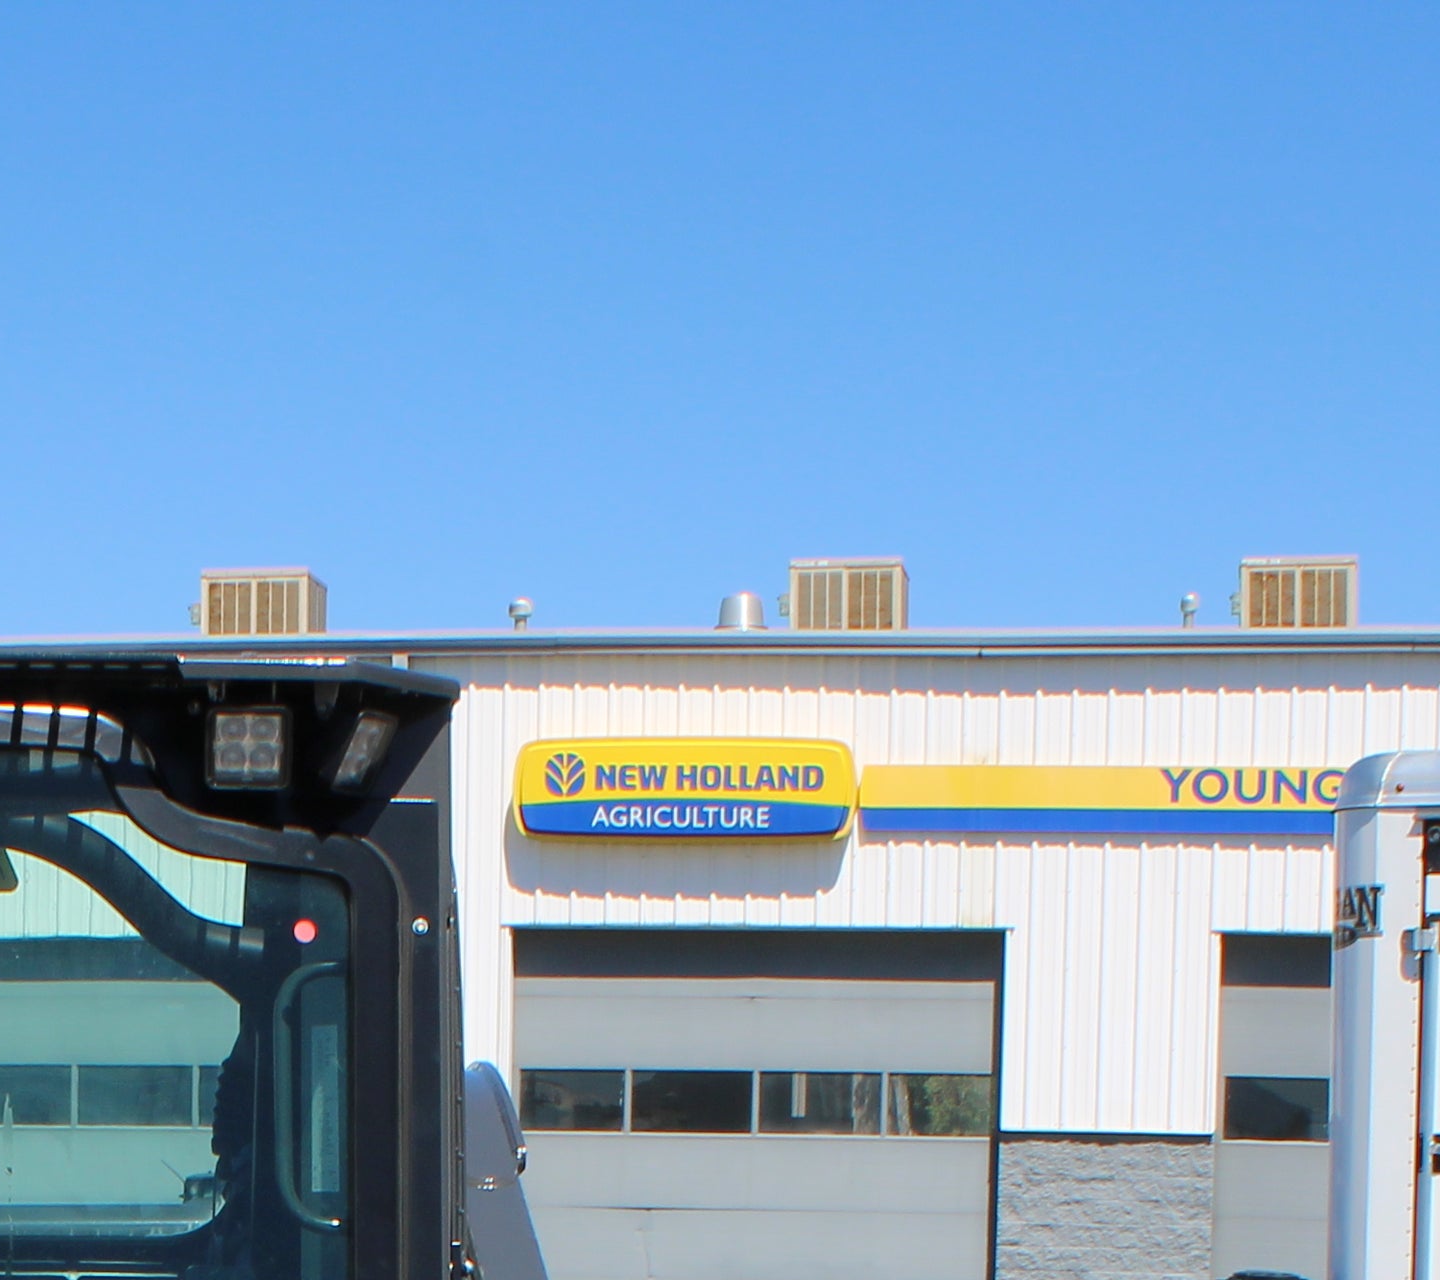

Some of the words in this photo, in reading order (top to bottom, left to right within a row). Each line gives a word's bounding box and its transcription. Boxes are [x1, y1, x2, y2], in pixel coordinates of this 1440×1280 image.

[594, 764, 667, 791] NEW
[676, 764, 824, 791] HOLLAND
[1160, 768, 1346, 805] YOUNG
[591, 806, 769, 829] AGRICULTURE
